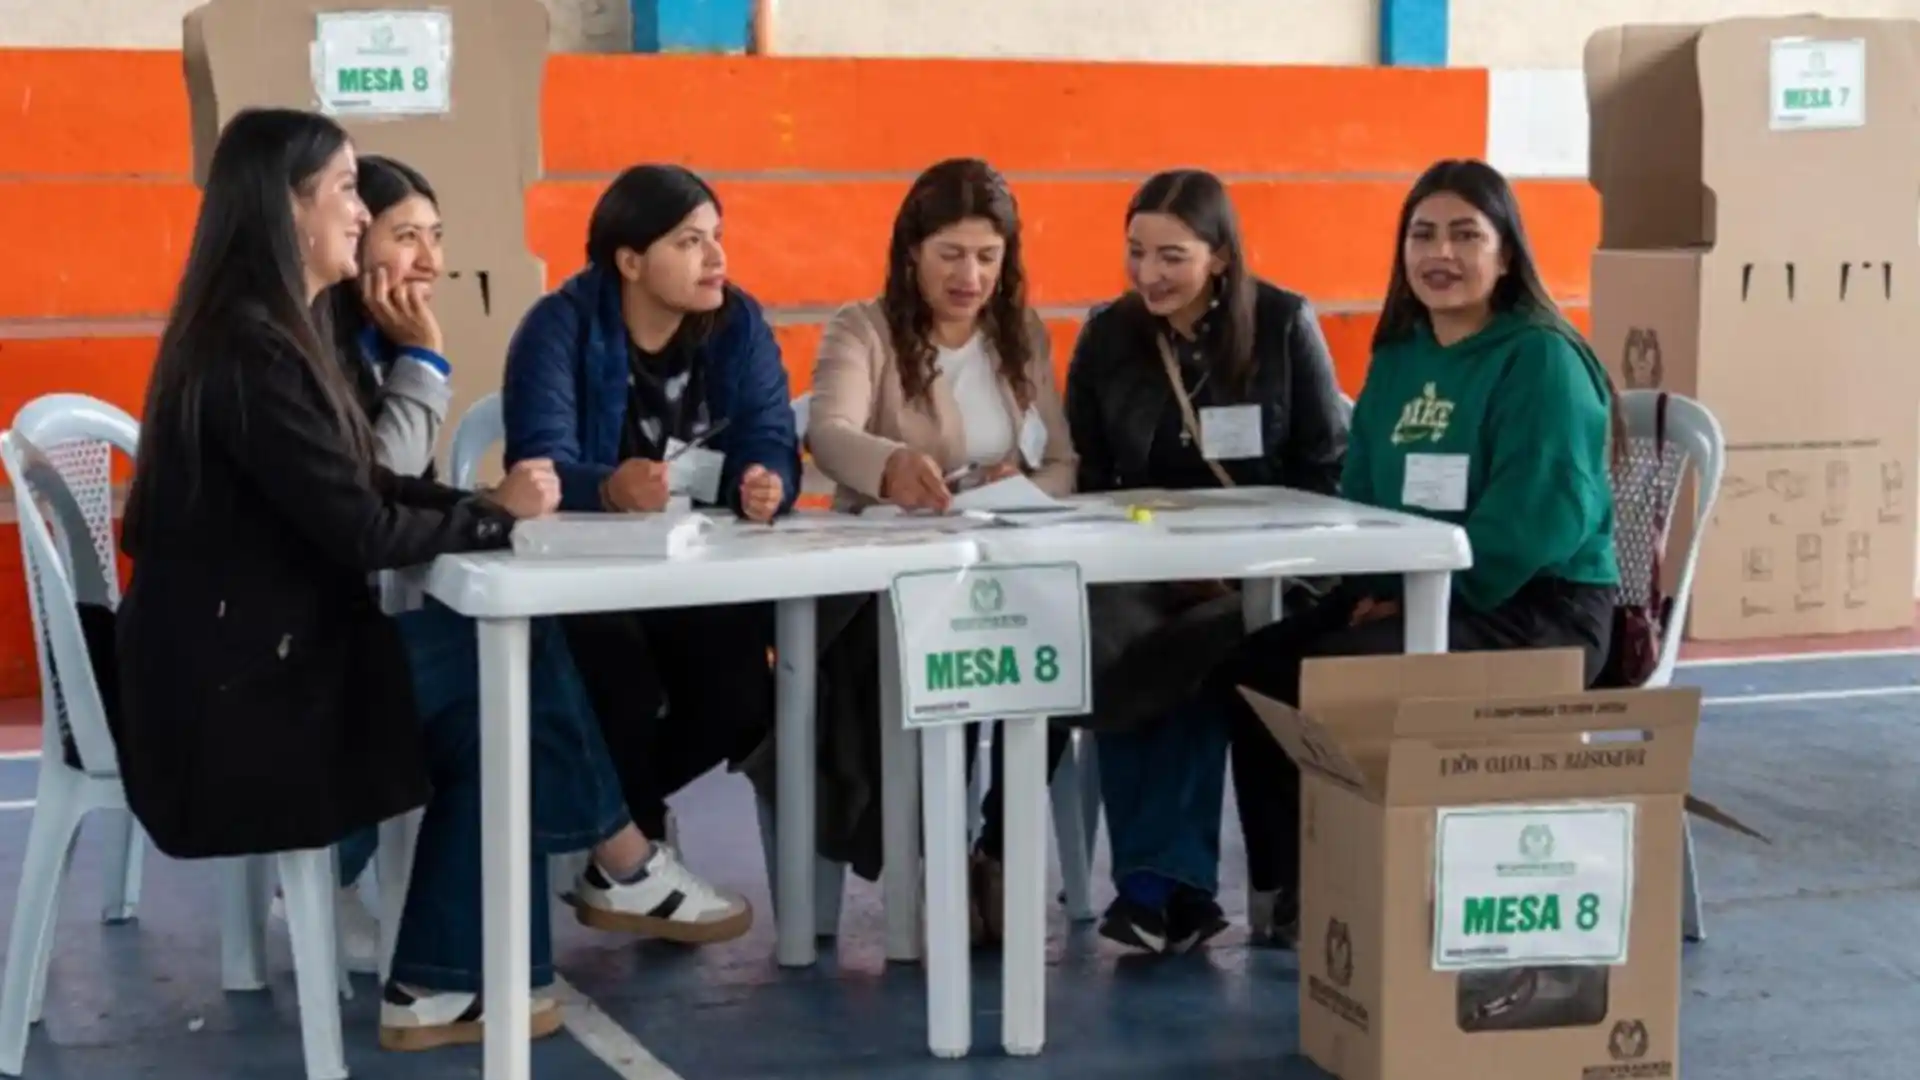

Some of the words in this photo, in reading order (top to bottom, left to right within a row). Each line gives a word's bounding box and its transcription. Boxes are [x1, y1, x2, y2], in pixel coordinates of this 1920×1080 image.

[337, 67, 404, 93] MESA
[412, 65, 429, 93] 8
[1784, 88, 1833, 110] MESA
[1839, 86, 1851, 108] 7
[926, 645, 1021, 692] MESA
[1034, 644, 1060, 683] 8
[1463, 893, 1561, 936] MESA
[1575, 892, 1600, 931] 8
